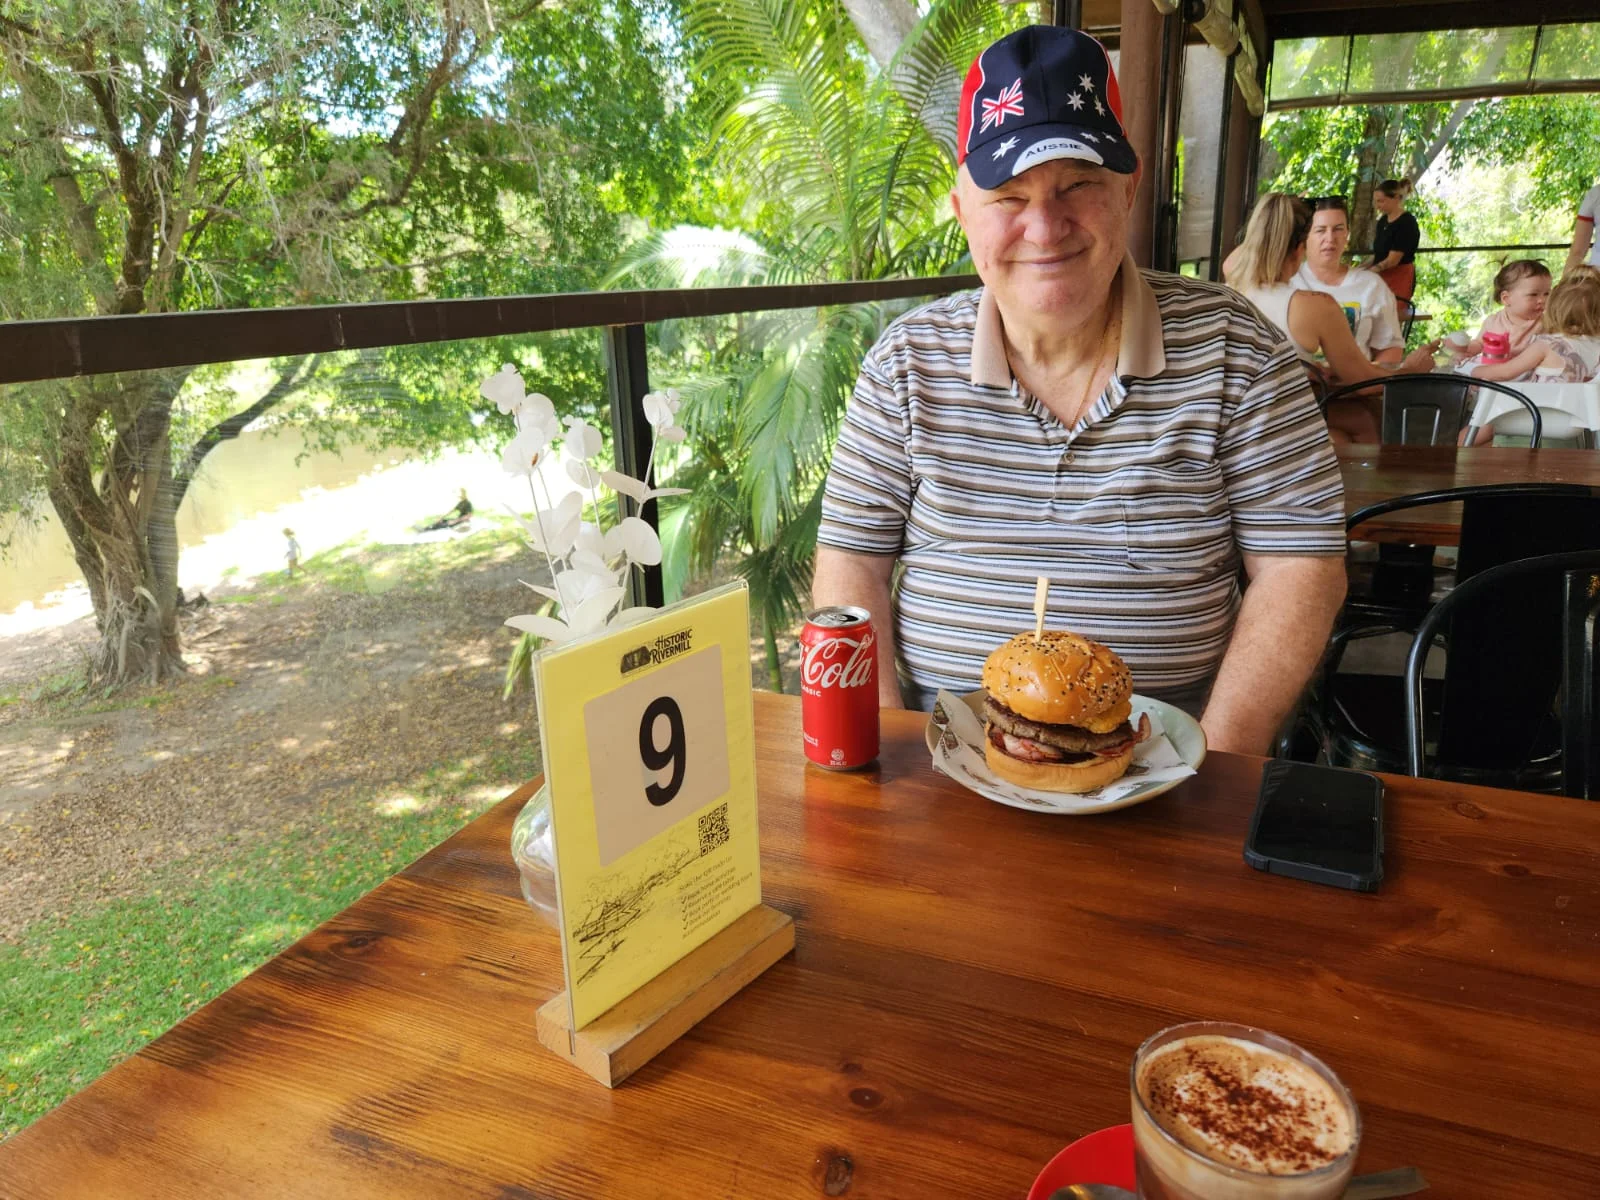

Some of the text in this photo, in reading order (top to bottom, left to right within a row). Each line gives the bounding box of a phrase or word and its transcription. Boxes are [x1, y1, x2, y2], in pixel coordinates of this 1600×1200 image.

[1025, 143, 1083, 159] AUSSIE
[655, 628, 693, 650] HISTORIC
[649, 640, 692, 664] RIVERMILL
[639, 696, 686, 807] 9
